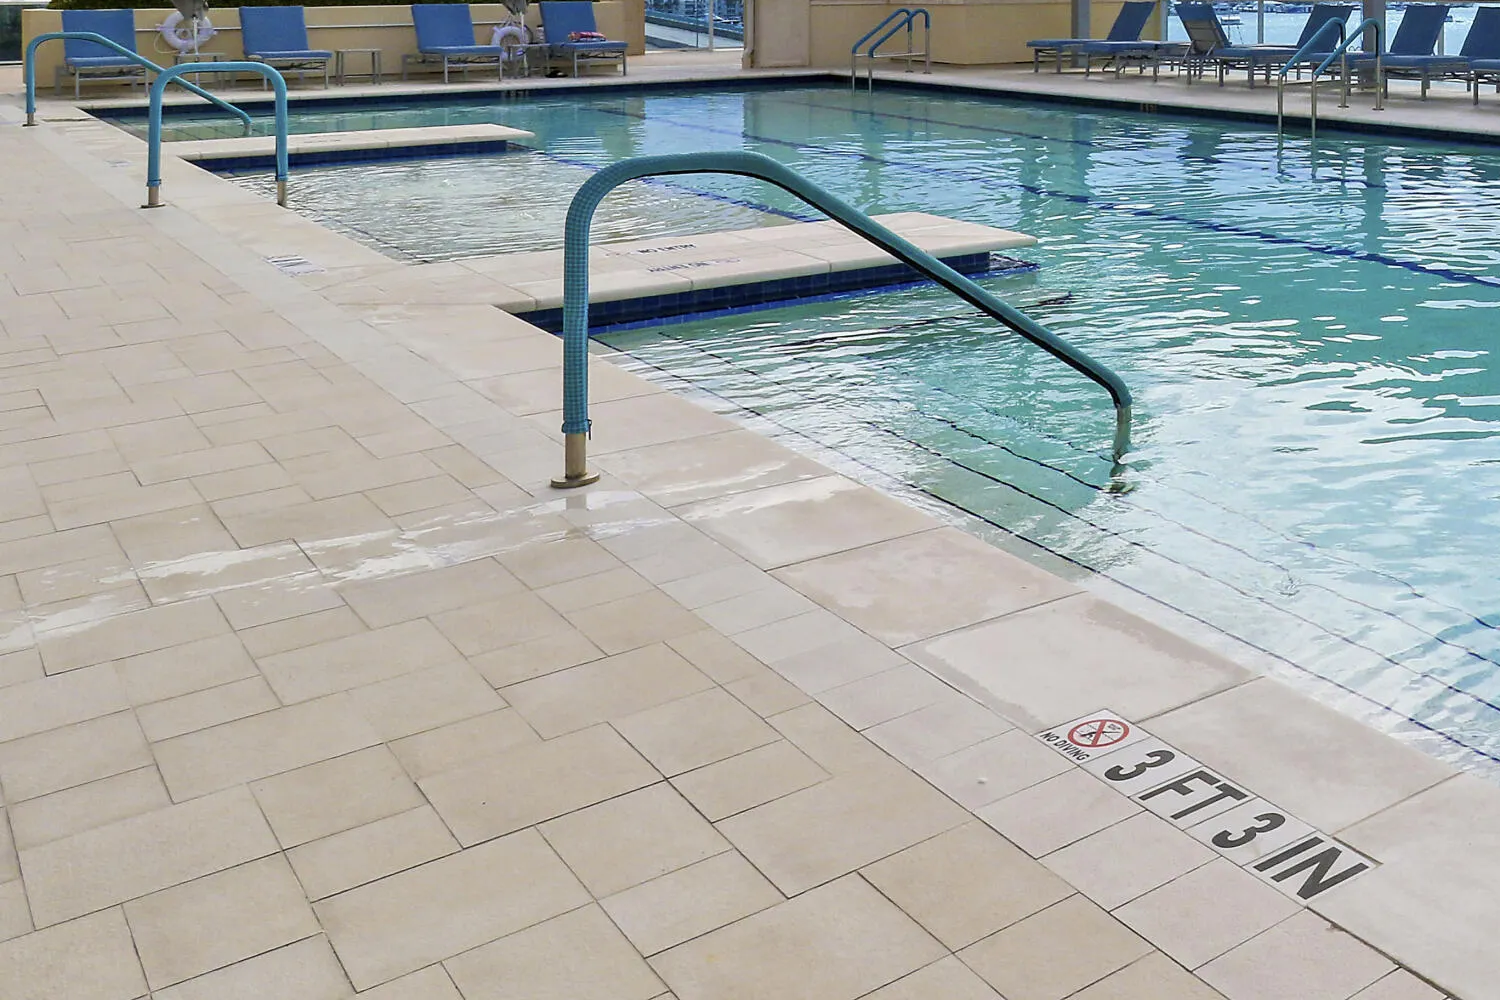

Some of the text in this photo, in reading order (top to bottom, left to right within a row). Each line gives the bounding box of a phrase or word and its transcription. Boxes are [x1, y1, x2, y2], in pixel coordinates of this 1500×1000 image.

[1040, 732, 1090, 761] NO DIVING
[1104, 749, 1370, 901] 3 FT 3 IN
